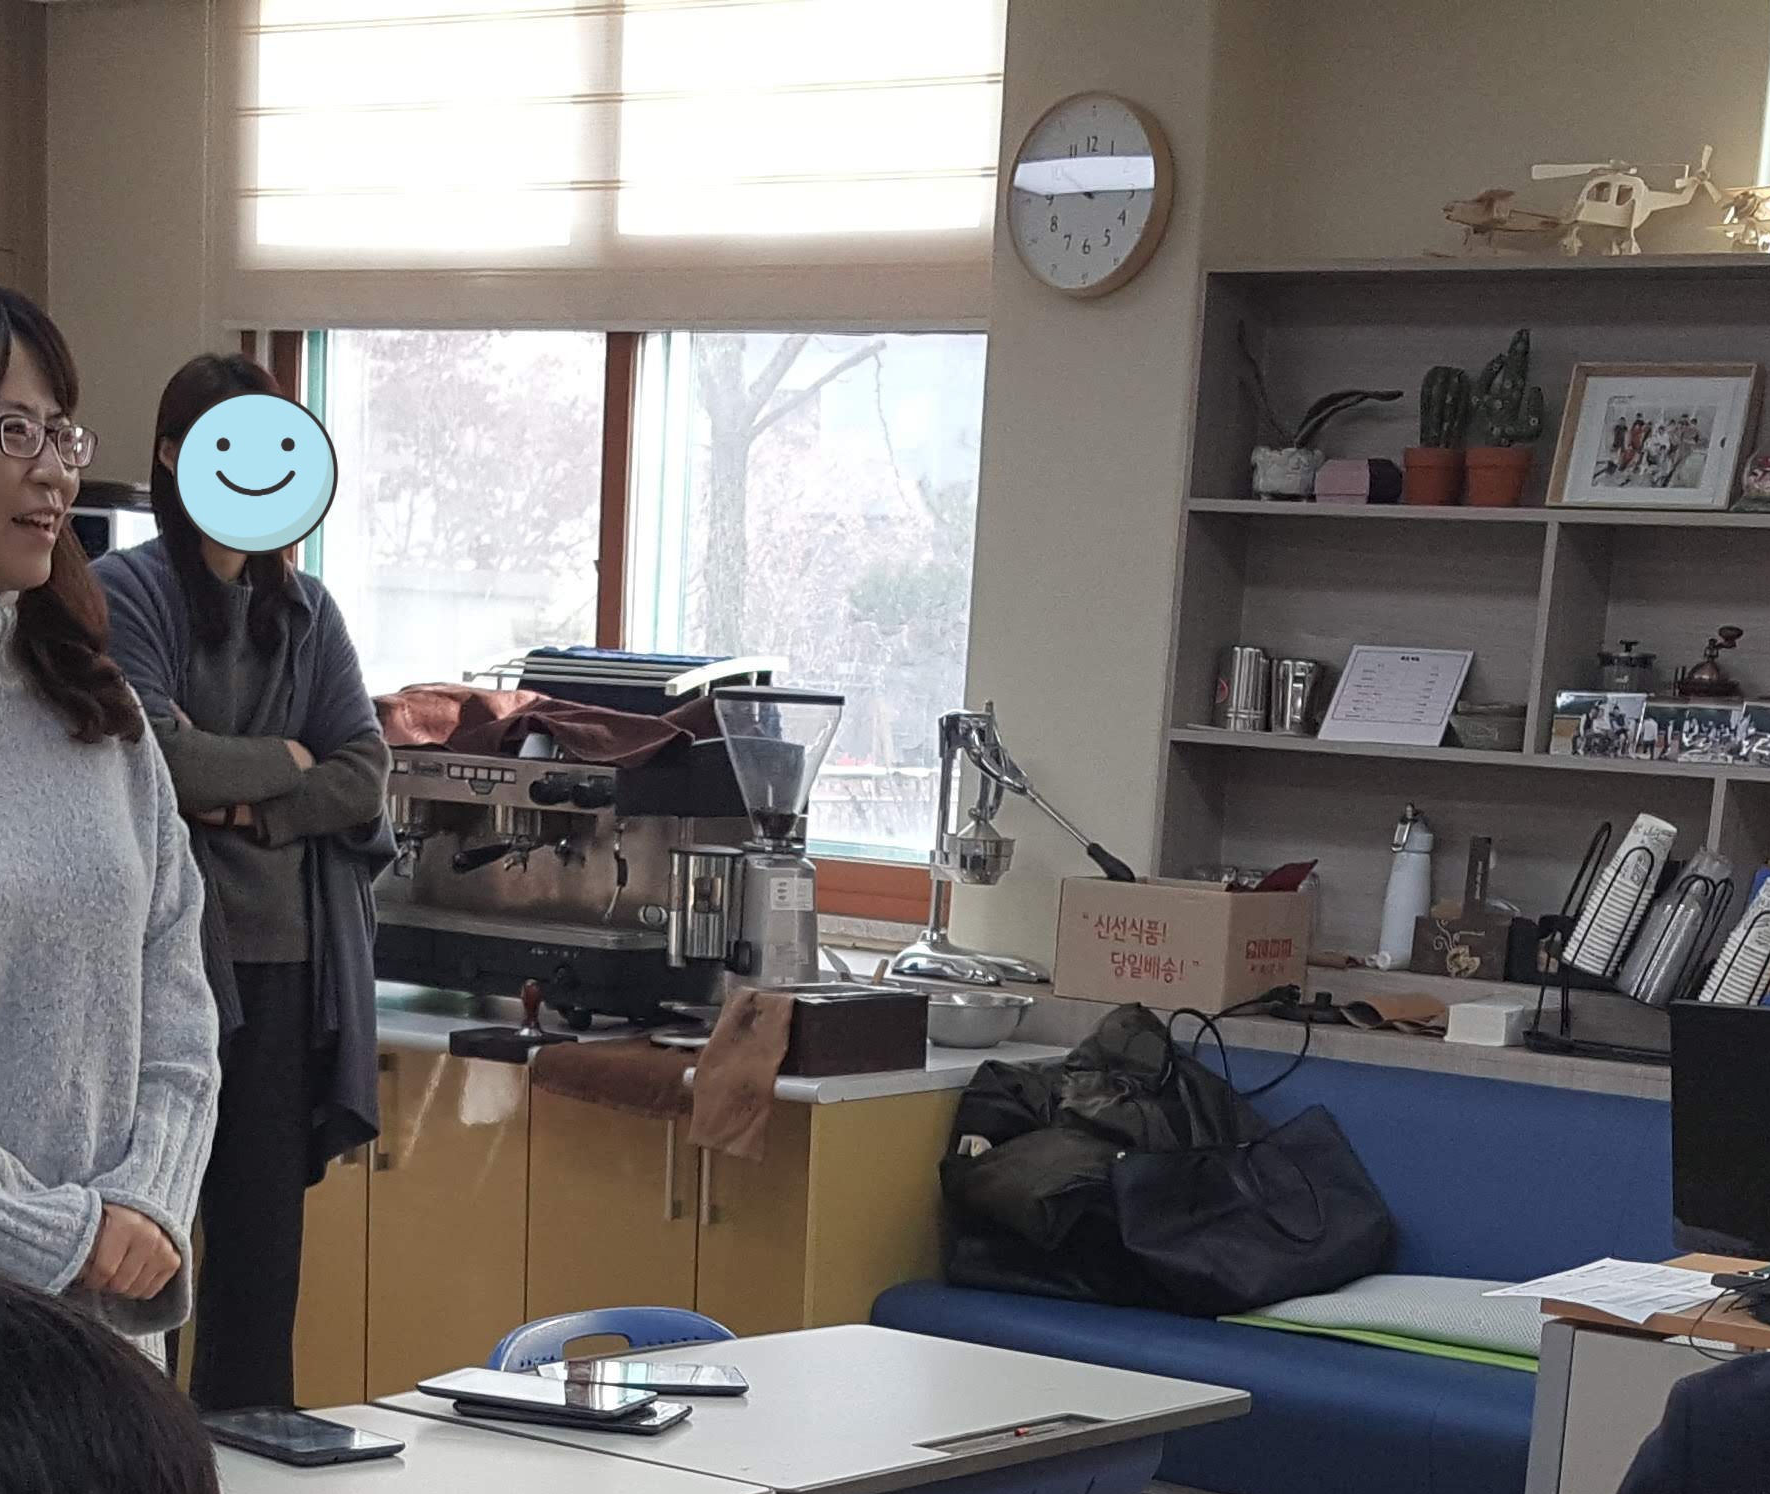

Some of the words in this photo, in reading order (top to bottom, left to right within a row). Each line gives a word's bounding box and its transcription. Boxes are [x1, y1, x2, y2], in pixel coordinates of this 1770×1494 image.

[1069, 143, 1078, 158] 11
[1086, 135, 1099, 153] 12
[1110, 140, 1115, 156] 1
[1049, 215, 1059, 233] 8
[1117, 209, 1127, 226] 4
[1063, 234, 1073, 251] 7
[1082, 238, 1092, 255] 6
[1103, 229, 1112, 247] 5
